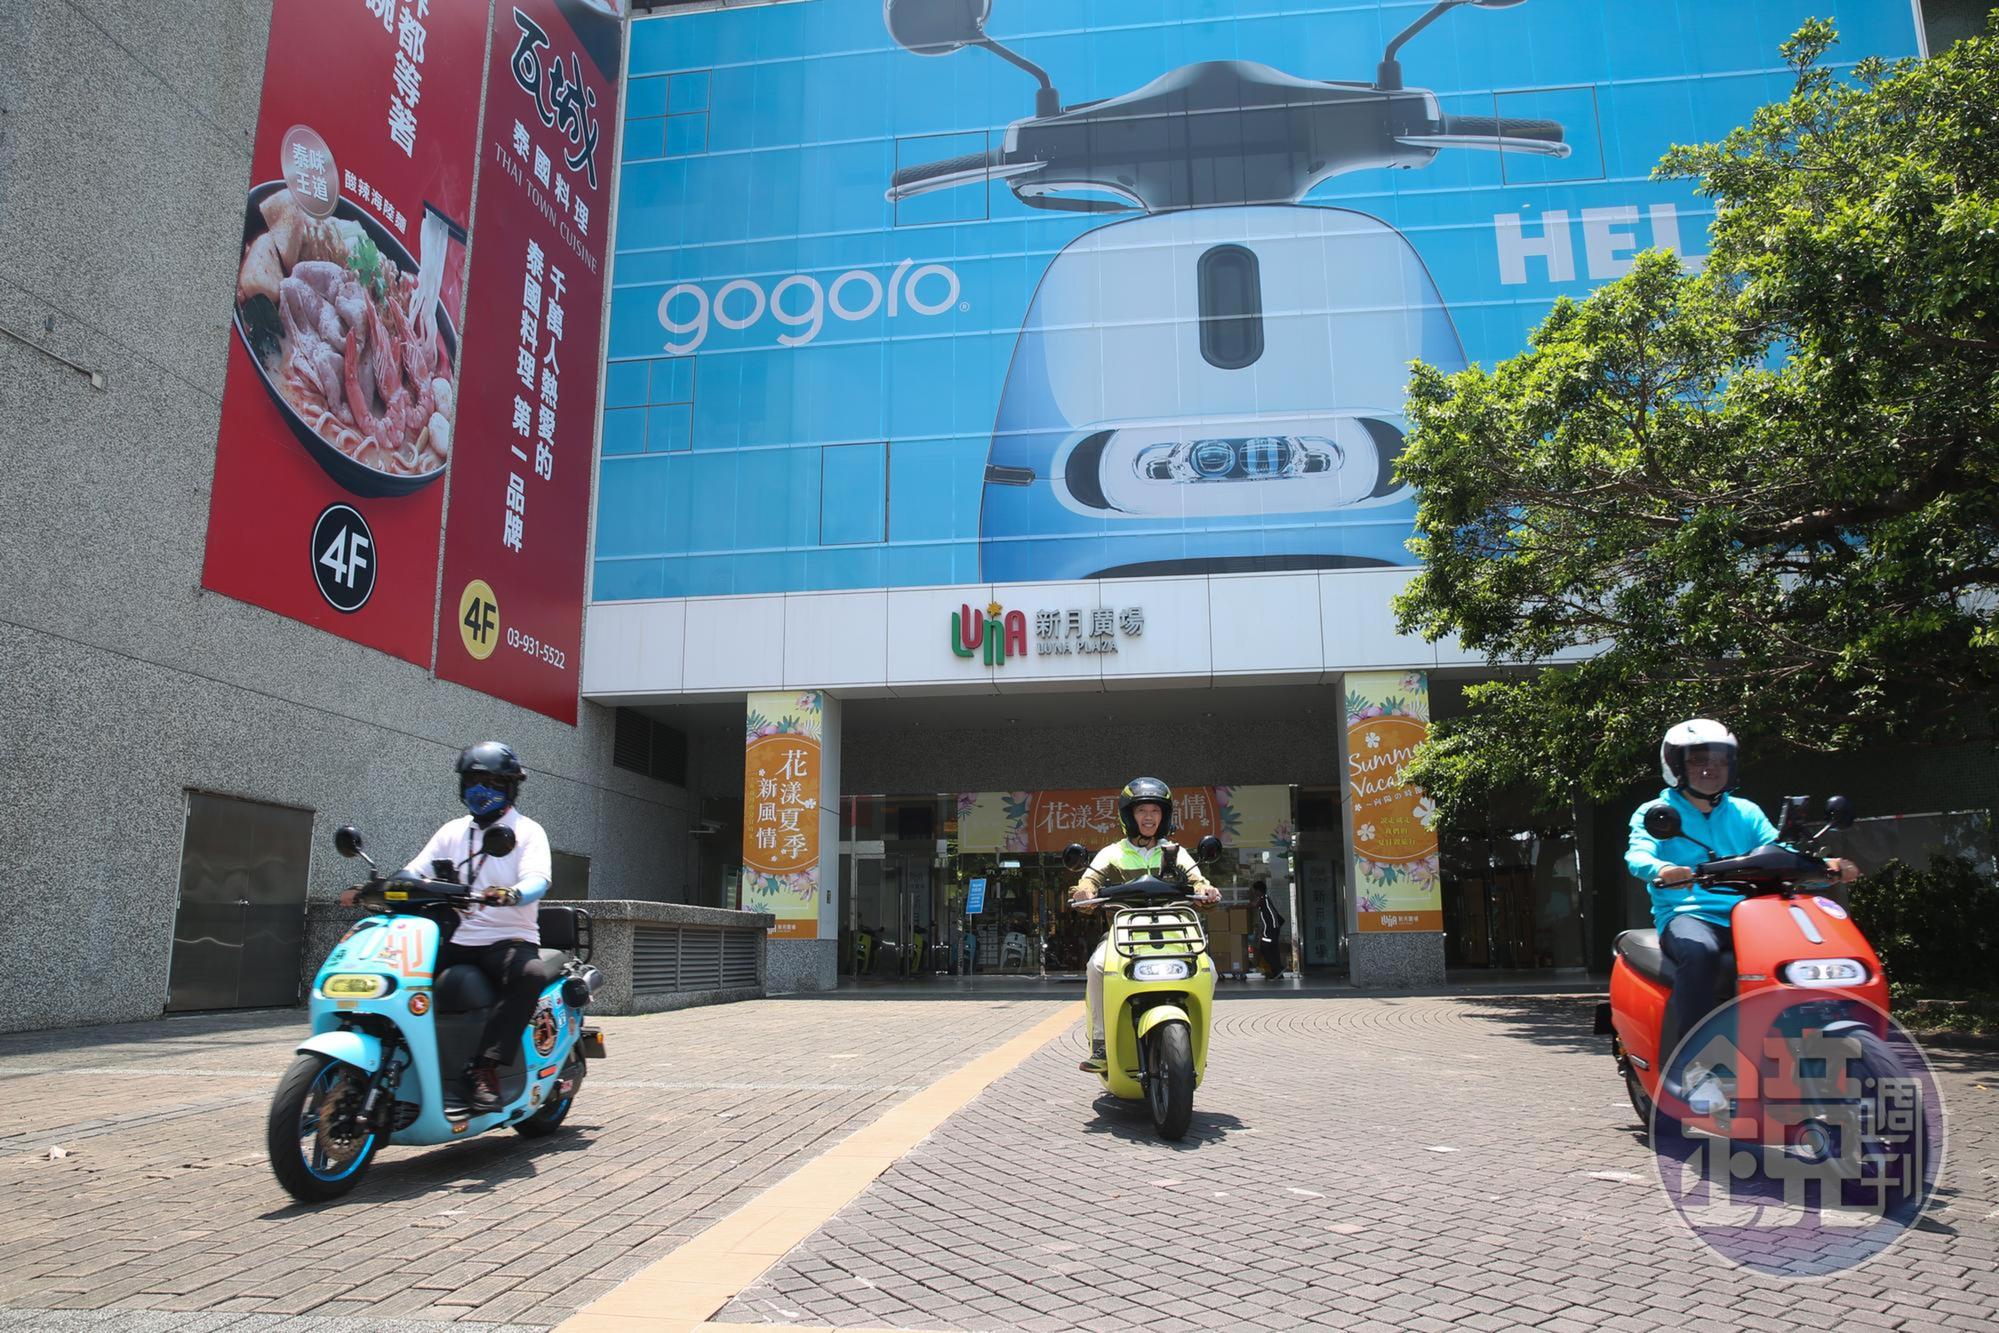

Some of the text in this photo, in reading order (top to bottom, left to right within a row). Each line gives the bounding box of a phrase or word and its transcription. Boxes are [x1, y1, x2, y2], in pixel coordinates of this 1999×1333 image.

[292, 142, 326, 175] 泰味
[296, 171, 329, 203] 王道
[512, 118, 590, 237] 泰國料理
[495, 142, 598, 275] THAI TOWN CUISINE
[1493, 203, 1708, 285] HEL
[657, 257, 961, 355] gogoro
[319, 524, 369, 589] 4F
[464, 596, 497, 645] 4F
[506, 627, 566, 670] 03-931-5522
[1036, 607, 1145, 639] 新月廣場
[1037, 641, 1118, 656] LUNA PLAZA
[756, 777, 778, 849] 新風情
[775, 749, 809, 860] 花漾夏季
